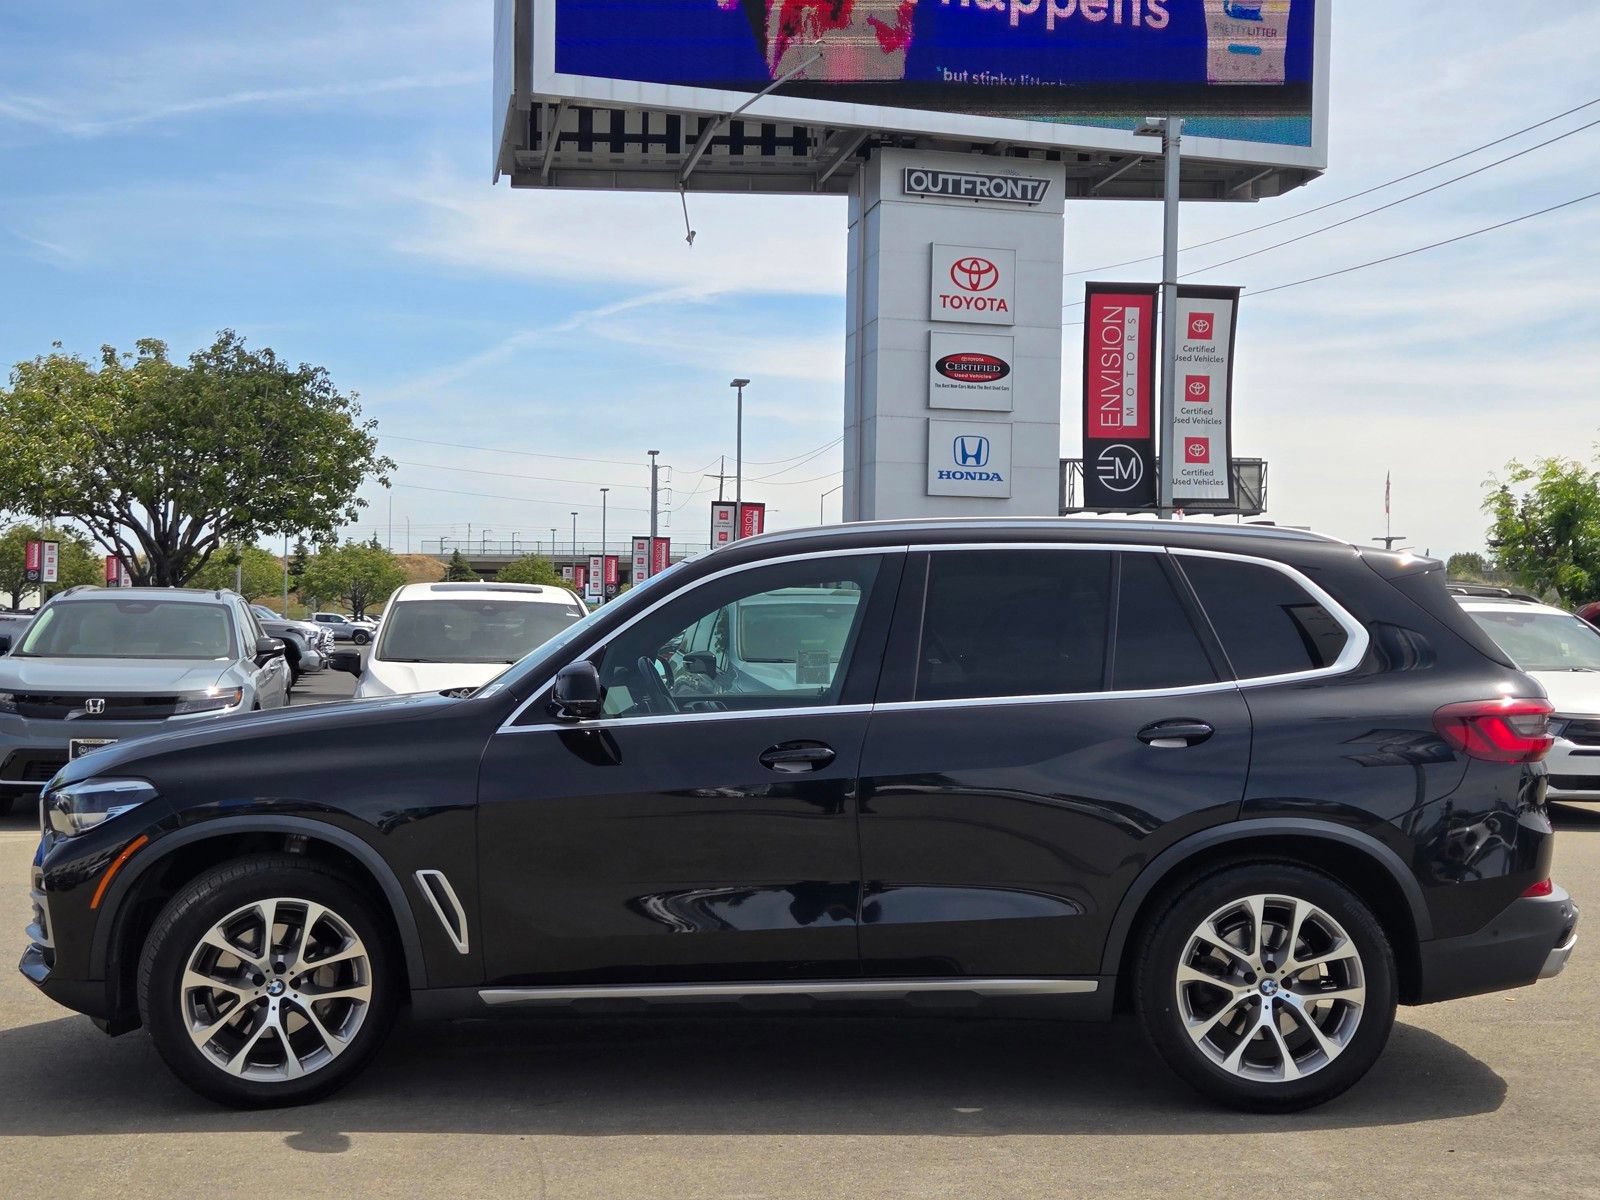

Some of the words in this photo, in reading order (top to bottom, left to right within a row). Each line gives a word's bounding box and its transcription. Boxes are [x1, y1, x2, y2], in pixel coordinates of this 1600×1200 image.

[940, 0, 1170, 31] ppens
[939, 294, 1009, 312] TOYOTA
[1182, 345, 1216, 353] Certified
[1193, 354, 1225, 363] Vehicles
[1100, 306, 1122, 427] ENVISION
[1126, 317, 1136, 417] MOTORS
[1180, 407, 1213, 415] Certified
[1192, 417, 1222, 425] Vehicles
[937, 470, 1004, 482] HONDA
[1181, 468, 1214, 476] Certified
[1172, 478, 1192, 486] Used
[1193, 478, 1225, 486] Vehicles
